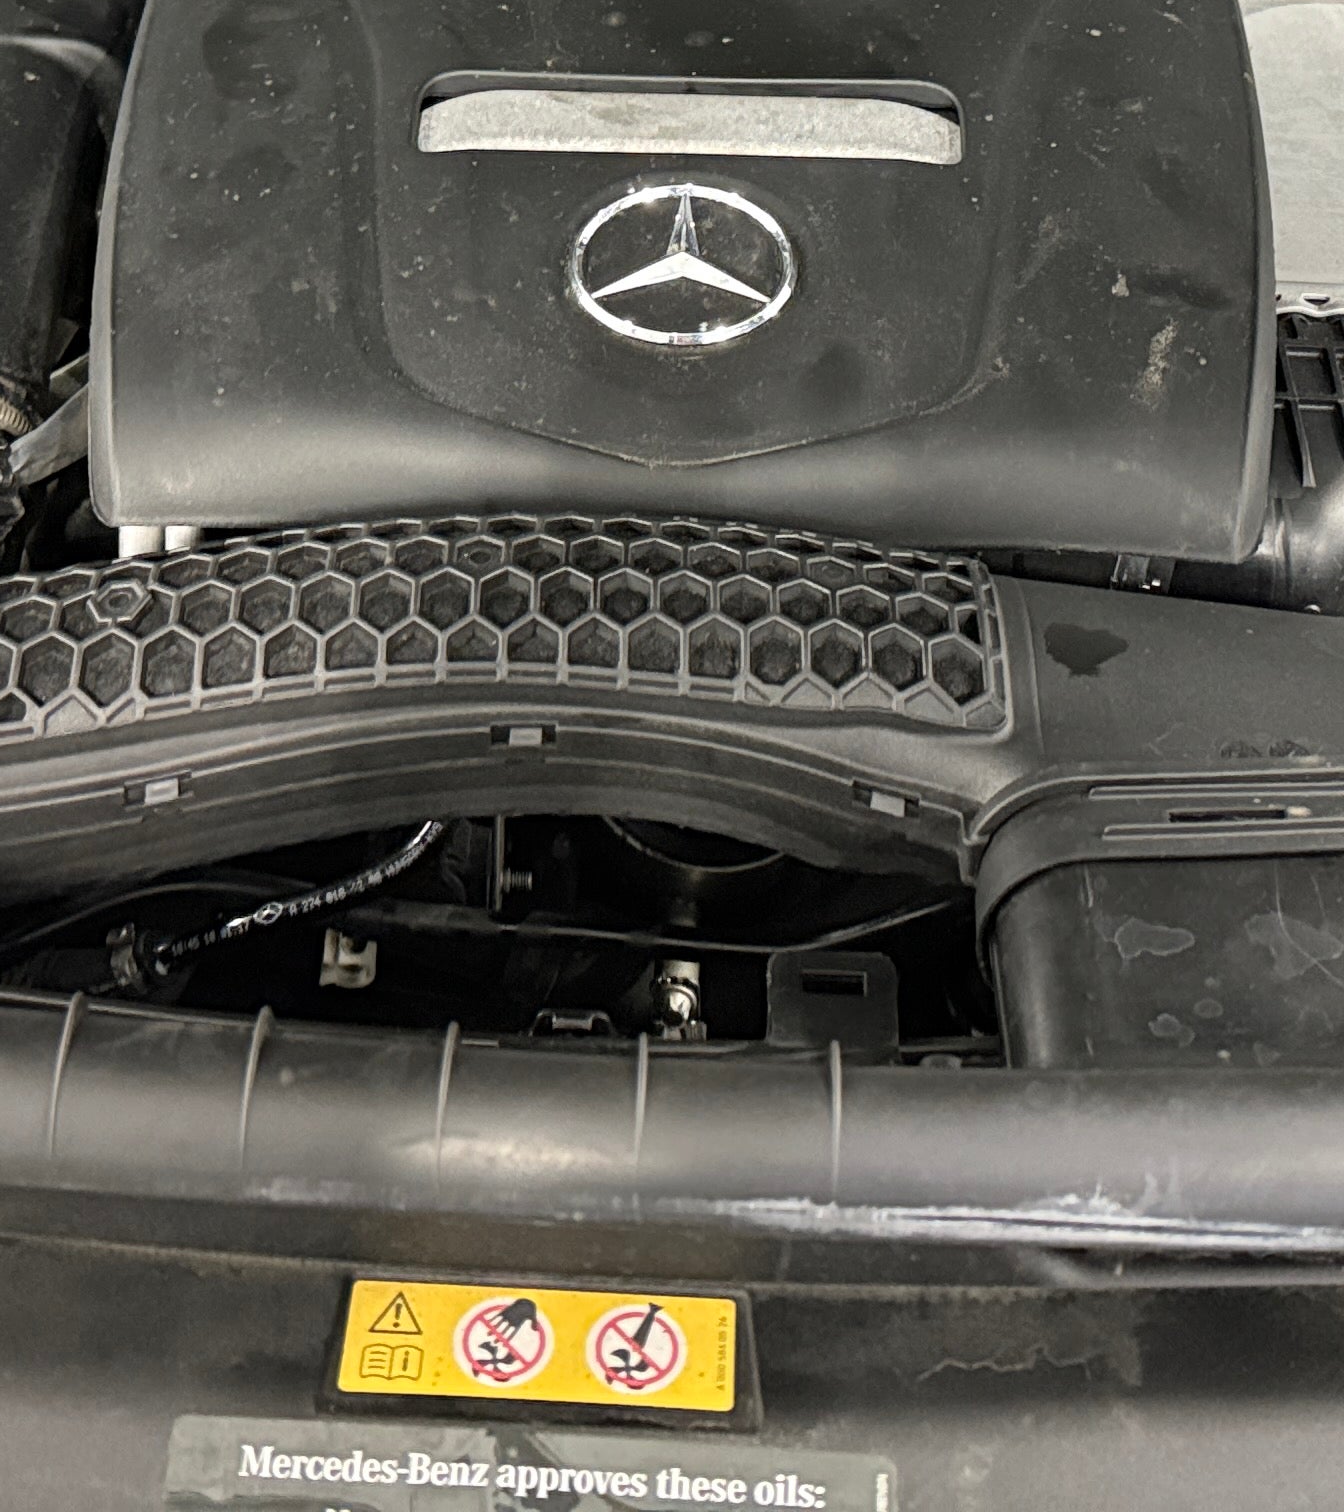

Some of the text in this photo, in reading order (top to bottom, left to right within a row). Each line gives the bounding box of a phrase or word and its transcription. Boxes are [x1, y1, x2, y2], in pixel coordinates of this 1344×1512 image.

[238, 1445, 826, 1509] Mercedes-Benz approves these oils:
